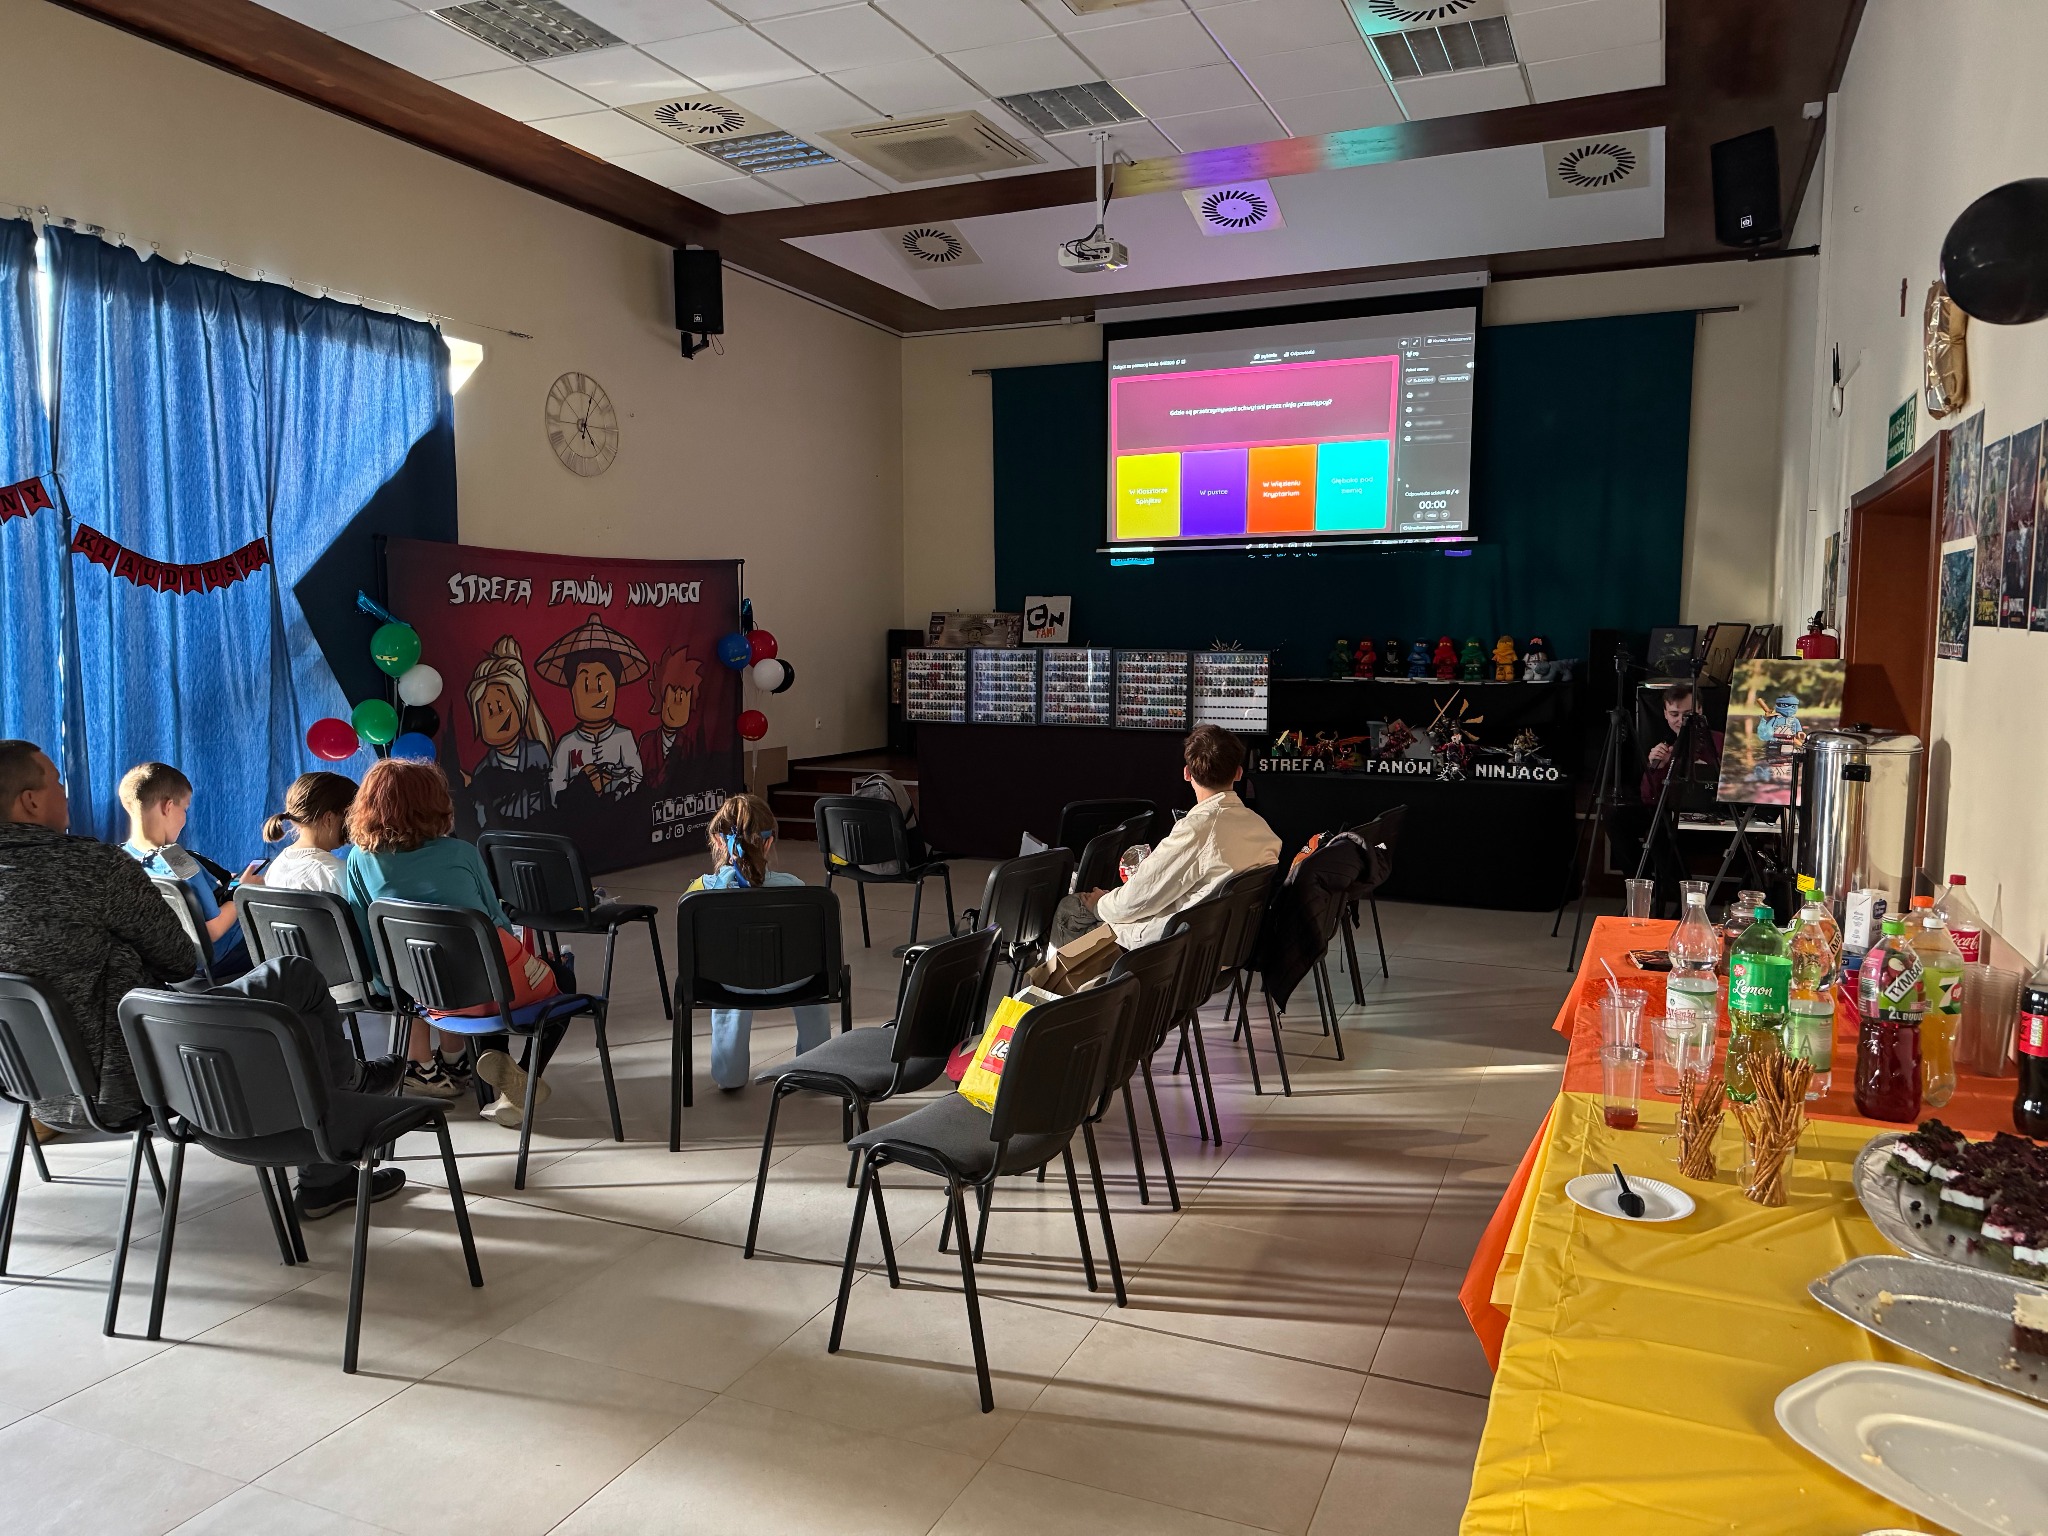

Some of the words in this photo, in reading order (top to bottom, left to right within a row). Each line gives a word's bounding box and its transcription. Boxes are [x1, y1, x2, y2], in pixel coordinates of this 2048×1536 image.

[1359, 476, 1374, 484] pod
[1207, 489, 1229, 497] pustce
[1262, 490, 1300, 499] Kryptarium
[1418, 499, 1447, 510] 00:00
[76, 531, 268, 586] KLAUDIUSZA
[448, 572, 532, 604] STREFA
[548, 574, 613, 608] FANÓW
[625, 579, 703, 609] NINJAGO
[570, 748, 584, 770] K
[1259, 758, 1325, 772] STREFA
[1366, 758, 1431, 775] FANÓW
[1475, 763, 1559, 781] NINJAGO
[655, 792, 725, 823] KLAUDIU
[1732, 978, 1774, 1000] Lemon
[990, 1039, 1011, 1059] LE
